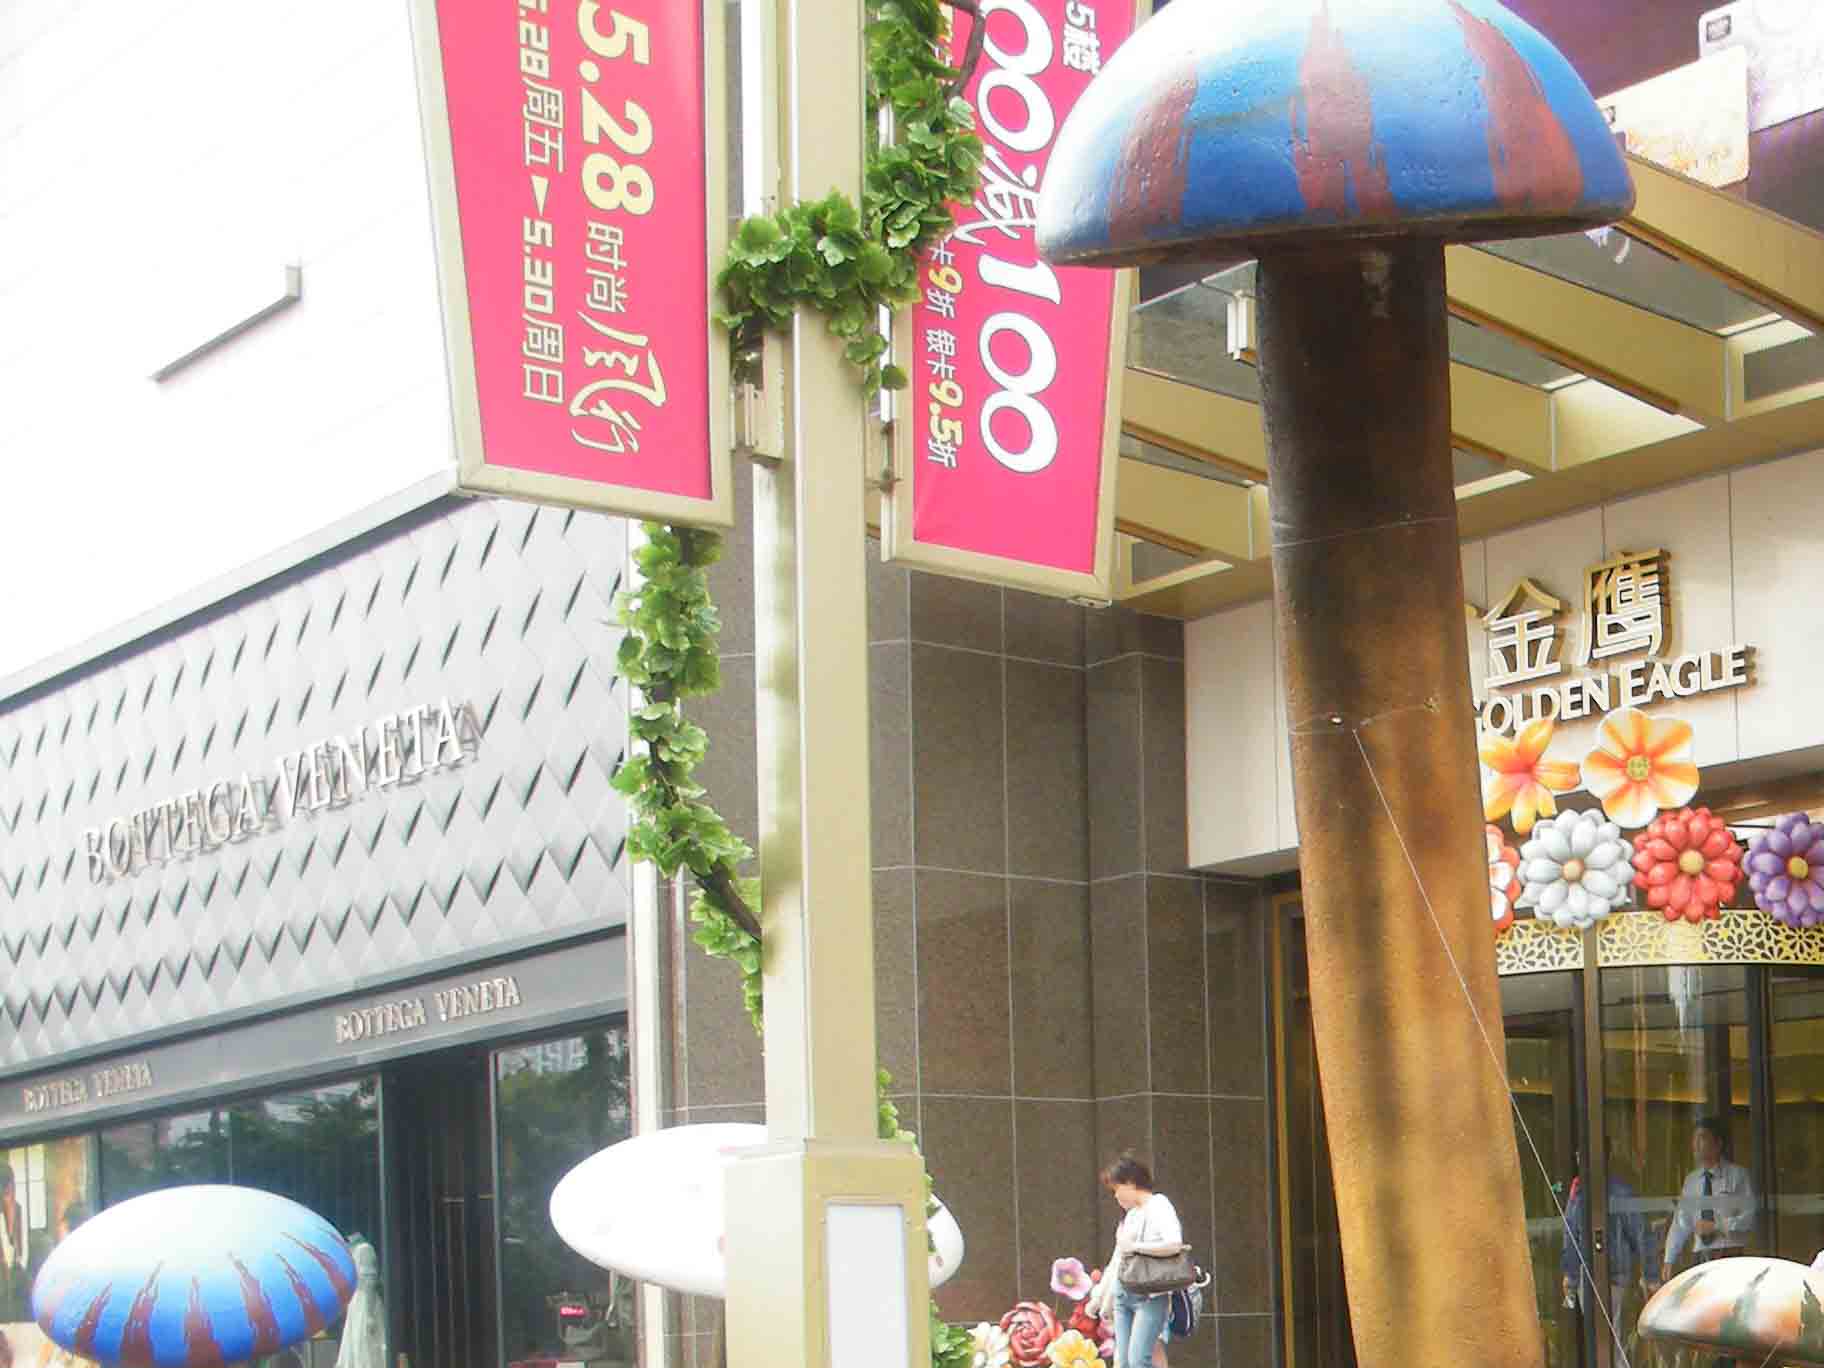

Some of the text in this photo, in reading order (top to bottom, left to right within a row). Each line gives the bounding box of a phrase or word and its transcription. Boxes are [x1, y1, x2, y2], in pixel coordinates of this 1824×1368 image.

[521, 216, 564, 404] 5.30周日
[1617, 644, 1748, 706] EAGLE
[85, 698, 464, 884] BOTTEGA VENETA
[335, 976, 521, 1043] BOTTEGA VENETA
